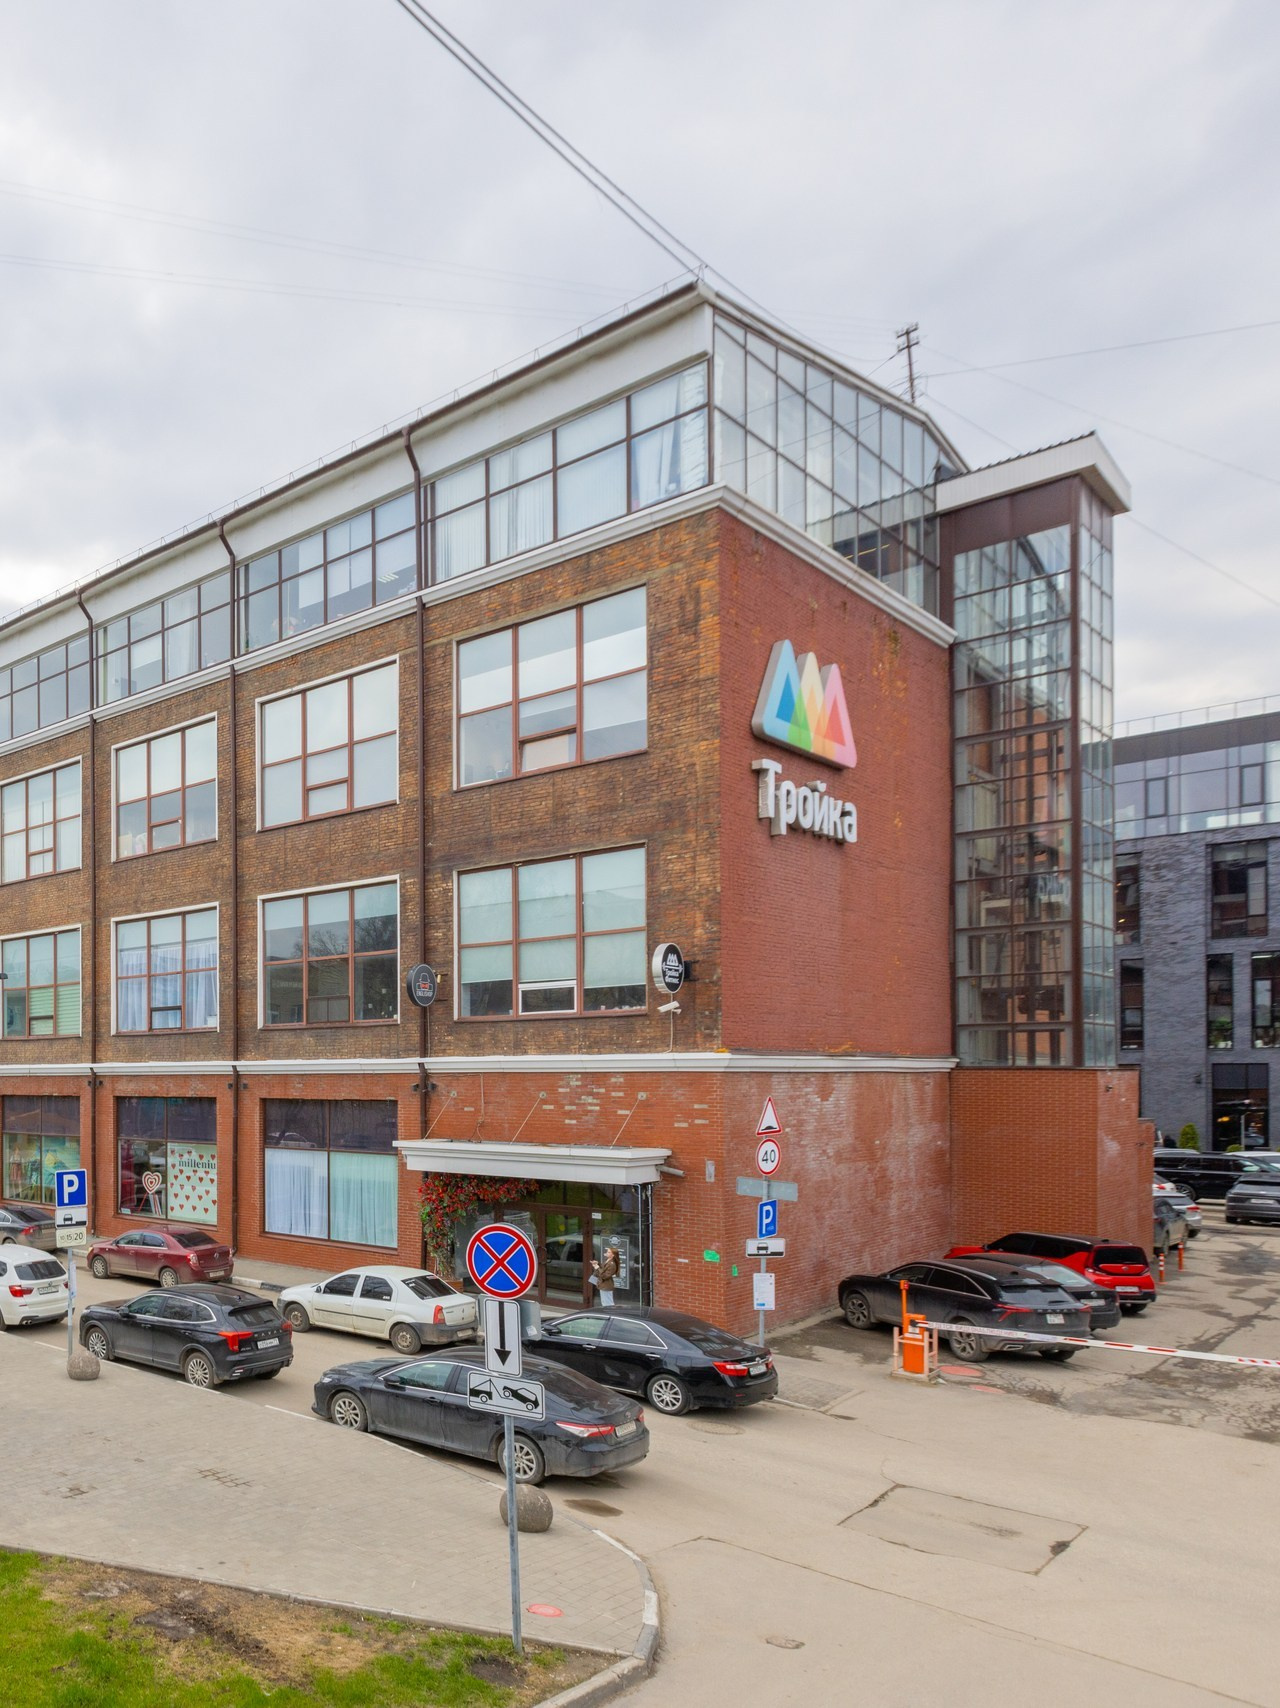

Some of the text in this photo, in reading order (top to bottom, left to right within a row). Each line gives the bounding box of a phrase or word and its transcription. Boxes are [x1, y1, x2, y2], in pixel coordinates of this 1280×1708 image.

[752, 758, 857, 843] Тройка
[761, 1149, 776, 1164] 40
[63, 1174, 79, 1204] P
[762, 1205, 774, 1234] P
[74, 1232, 83, 1240] 20
